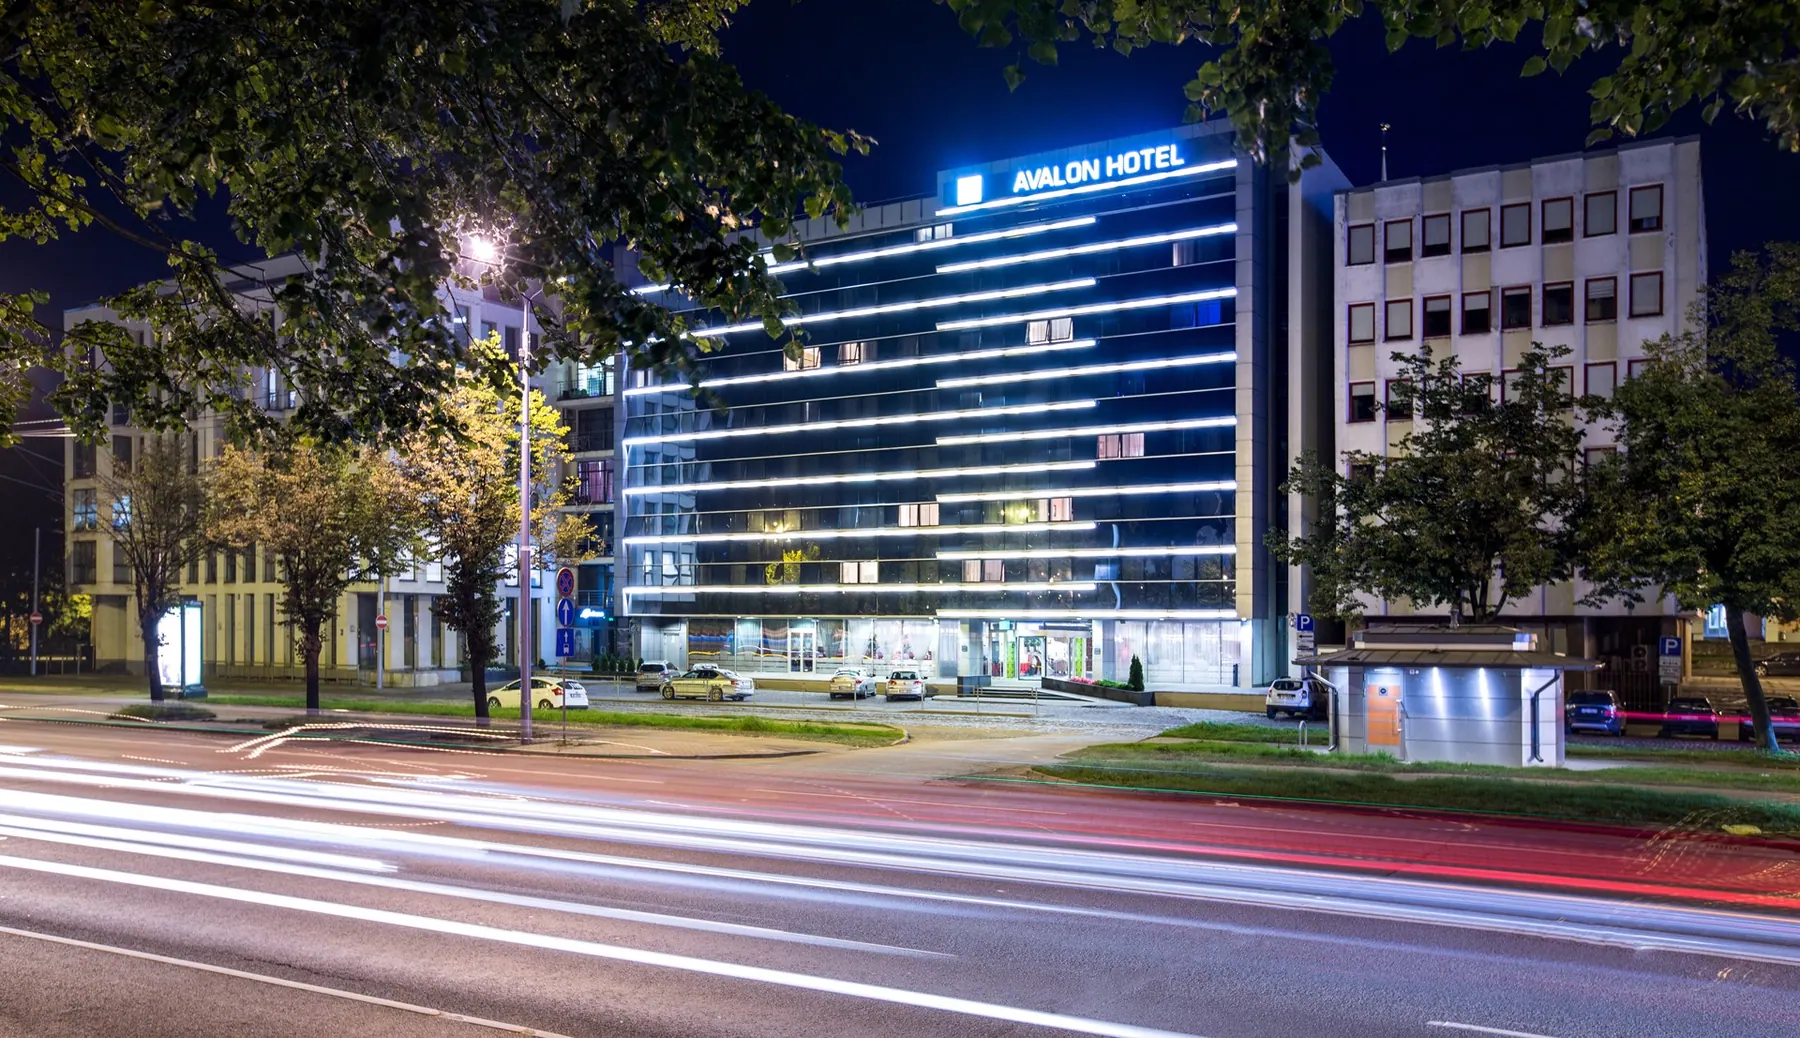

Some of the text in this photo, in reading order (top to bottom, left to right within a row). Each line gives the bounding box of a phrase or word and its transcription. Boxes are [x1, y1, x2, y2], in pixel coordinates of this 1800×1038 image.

[1013, 143, 1185, 193] AVALON HOTEL
[1300, 615, 1310, 630] P
[1665, 638, 1678, 655] P
